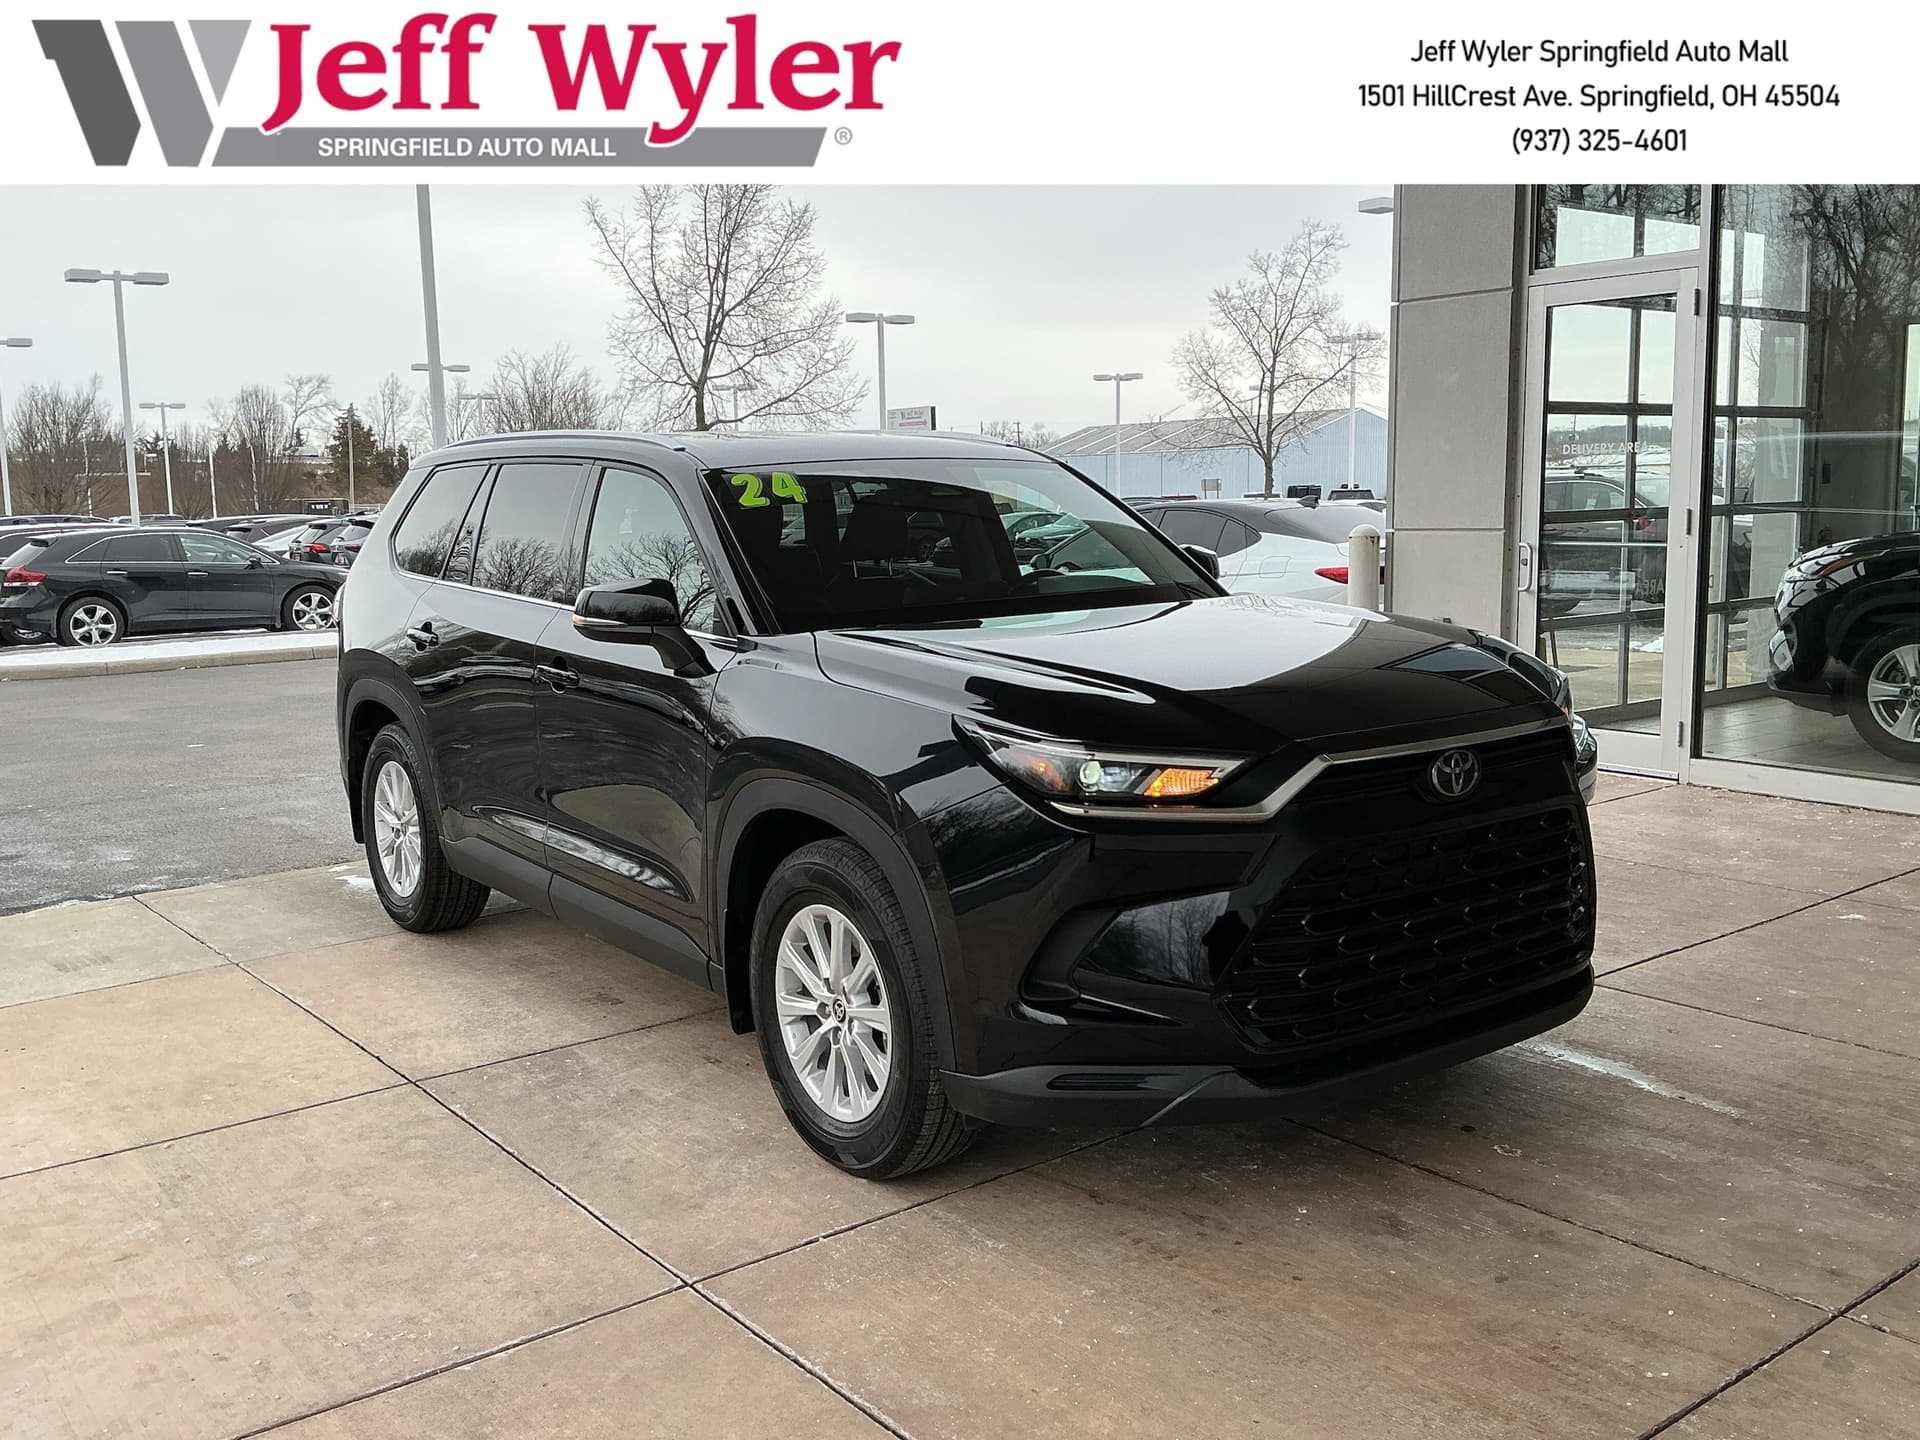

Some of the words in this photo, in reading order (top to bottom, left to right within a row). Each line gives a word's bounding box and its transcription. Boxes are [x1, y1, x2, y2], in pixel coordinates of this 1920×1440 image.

[1562, 442, 1615, 455] DELIVERY
[1618, 440, 1649, 454] AREA
[731, 472, 808, 508] 24
